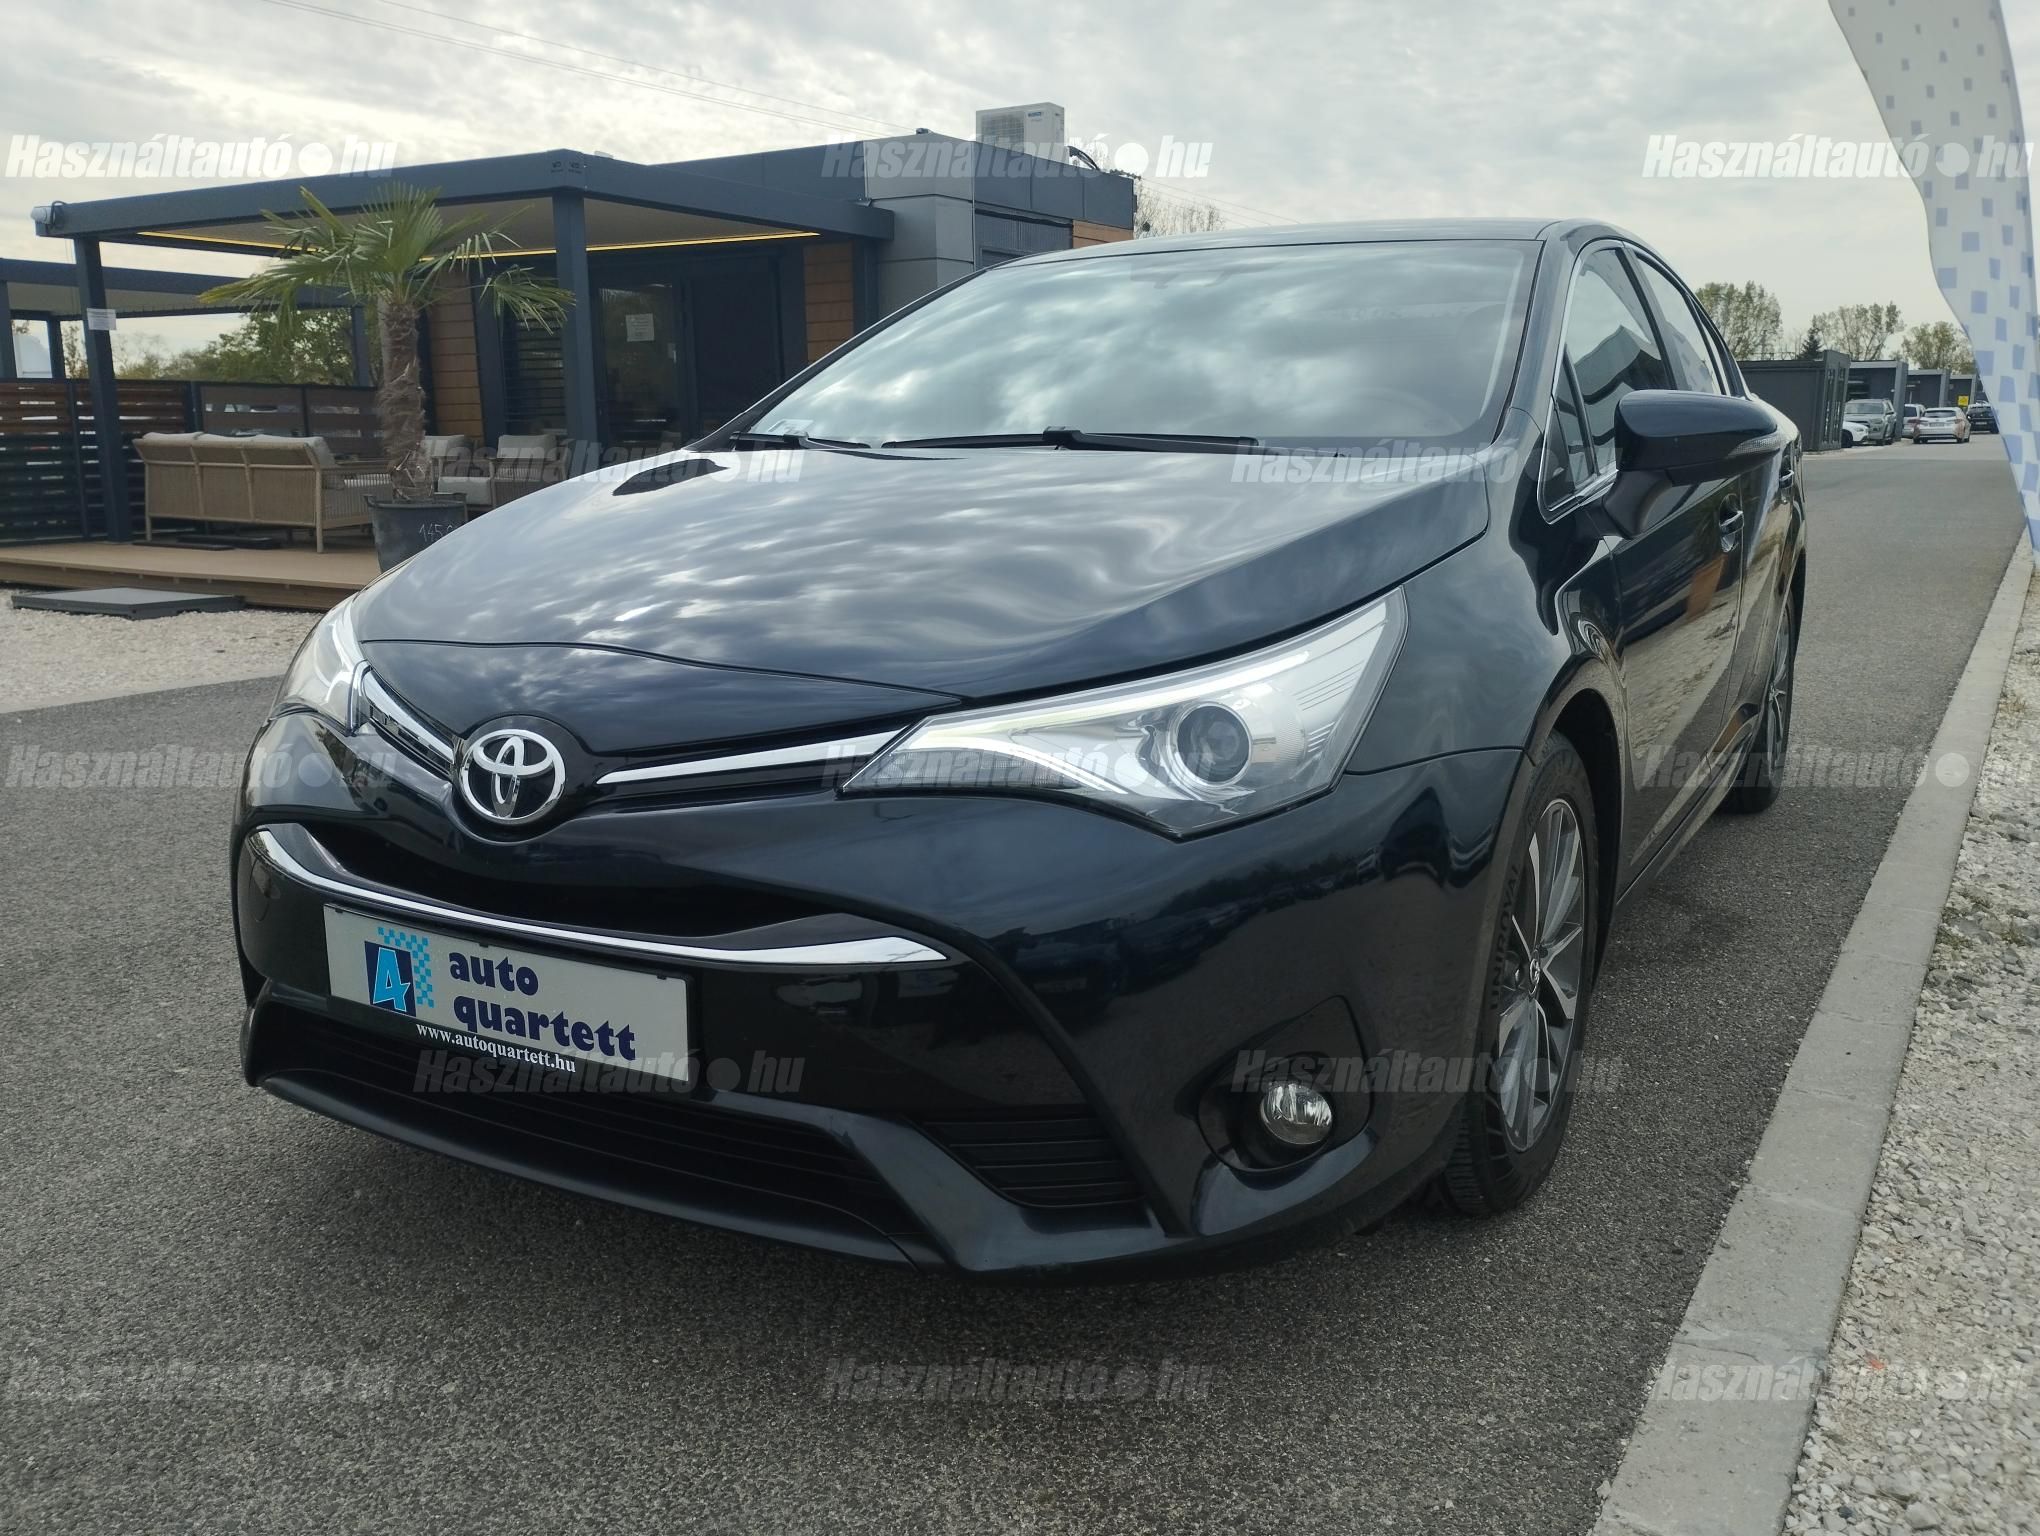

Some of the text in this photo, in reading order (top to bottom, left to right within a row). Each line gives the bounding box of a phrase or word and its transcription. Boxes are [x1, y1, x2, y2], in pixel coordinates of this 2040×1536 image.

[449, 951, 539, 997] auto
[416, 1023, 576, 1073] www.autoquartett.hu
[453, 995, 636, 1061] quartett
